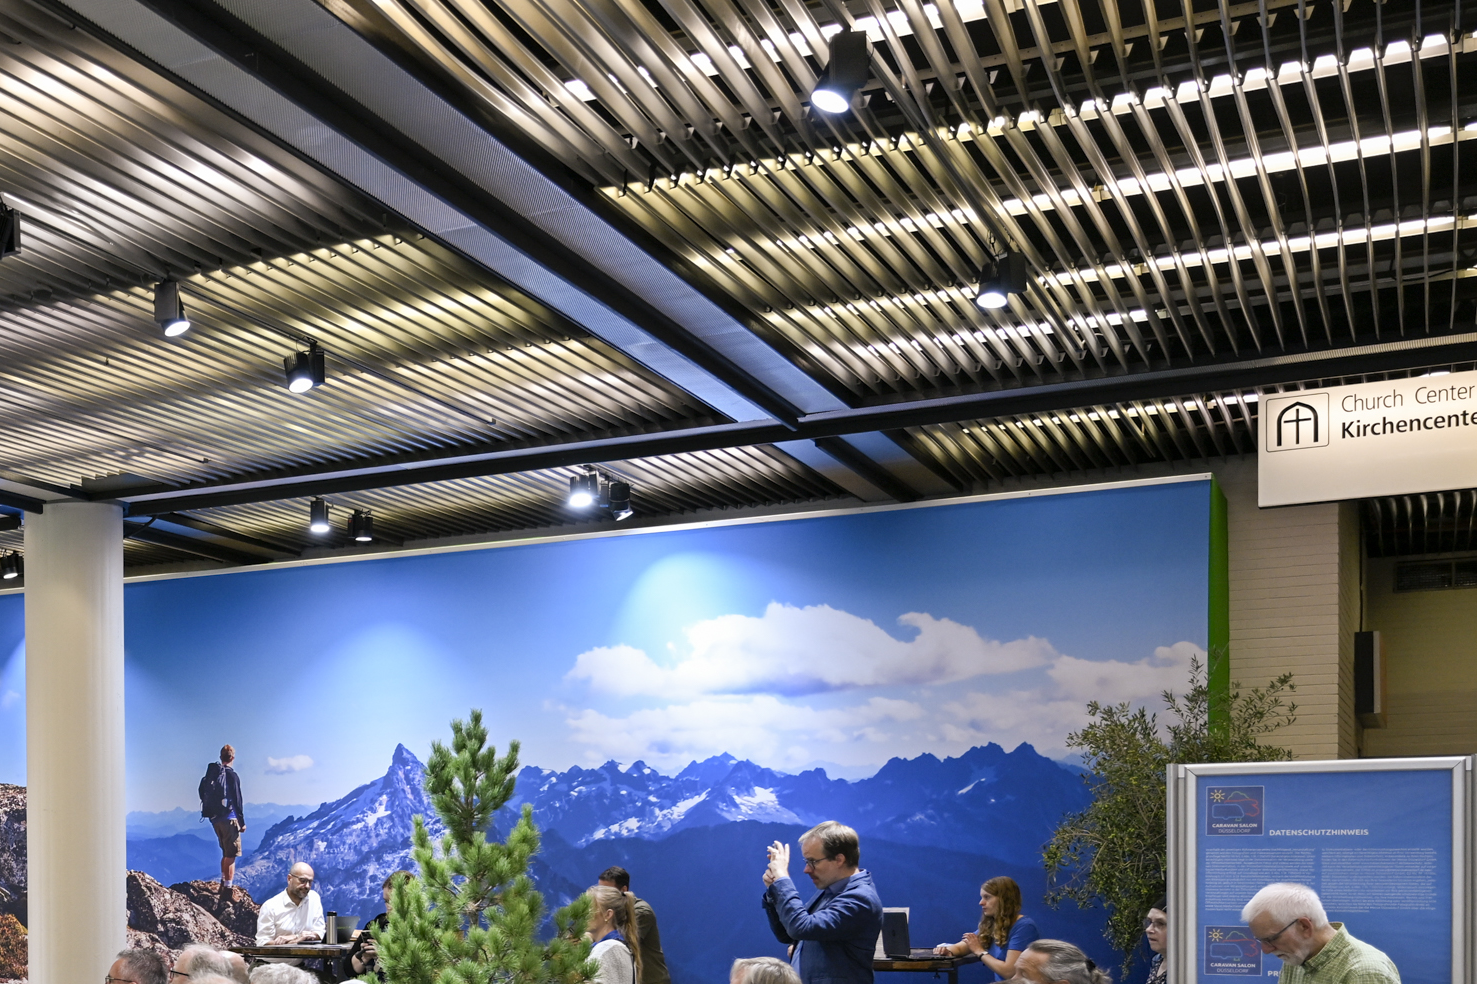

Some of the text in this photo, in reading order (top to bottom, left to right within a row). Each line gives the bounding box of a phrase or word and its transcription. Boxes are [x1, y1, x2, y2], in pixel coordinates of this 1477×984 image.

[1341, 384, 1476, 413] Church Center
[1268, 828, 1370, 837] DATENSCHUTZHINWEIS
